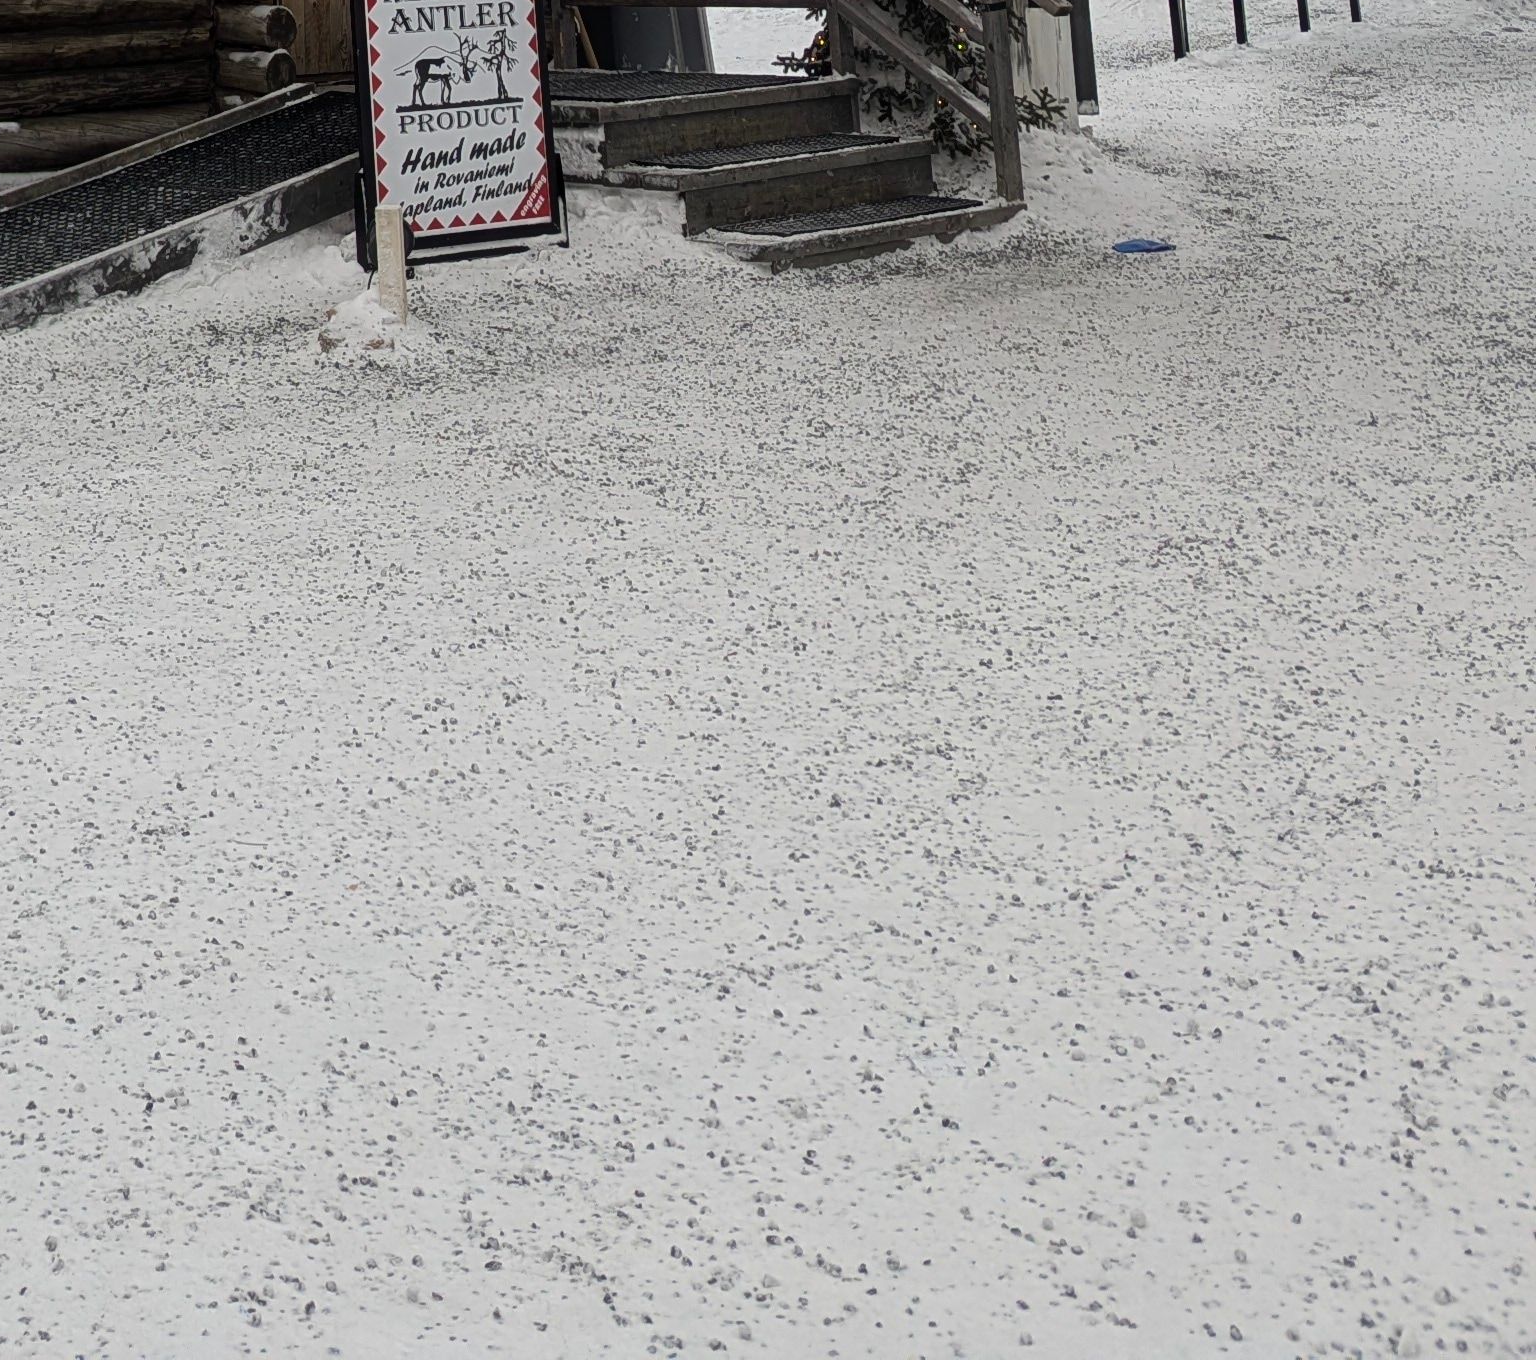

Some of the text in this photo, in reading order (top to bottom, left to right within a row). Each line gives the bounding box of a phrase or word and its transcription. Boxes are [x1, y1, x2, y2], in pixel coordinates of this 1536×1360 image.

[388, 1, 520, 35] ANTLER
[398, 104, 524, 135] PRODUCT
[400, 128, 527, 176] Hand made
[414, 156, 515, 195] in Rovaniemi
[472, 172, 534, 204] Finland
[520, 174, 547, 218] engraving
